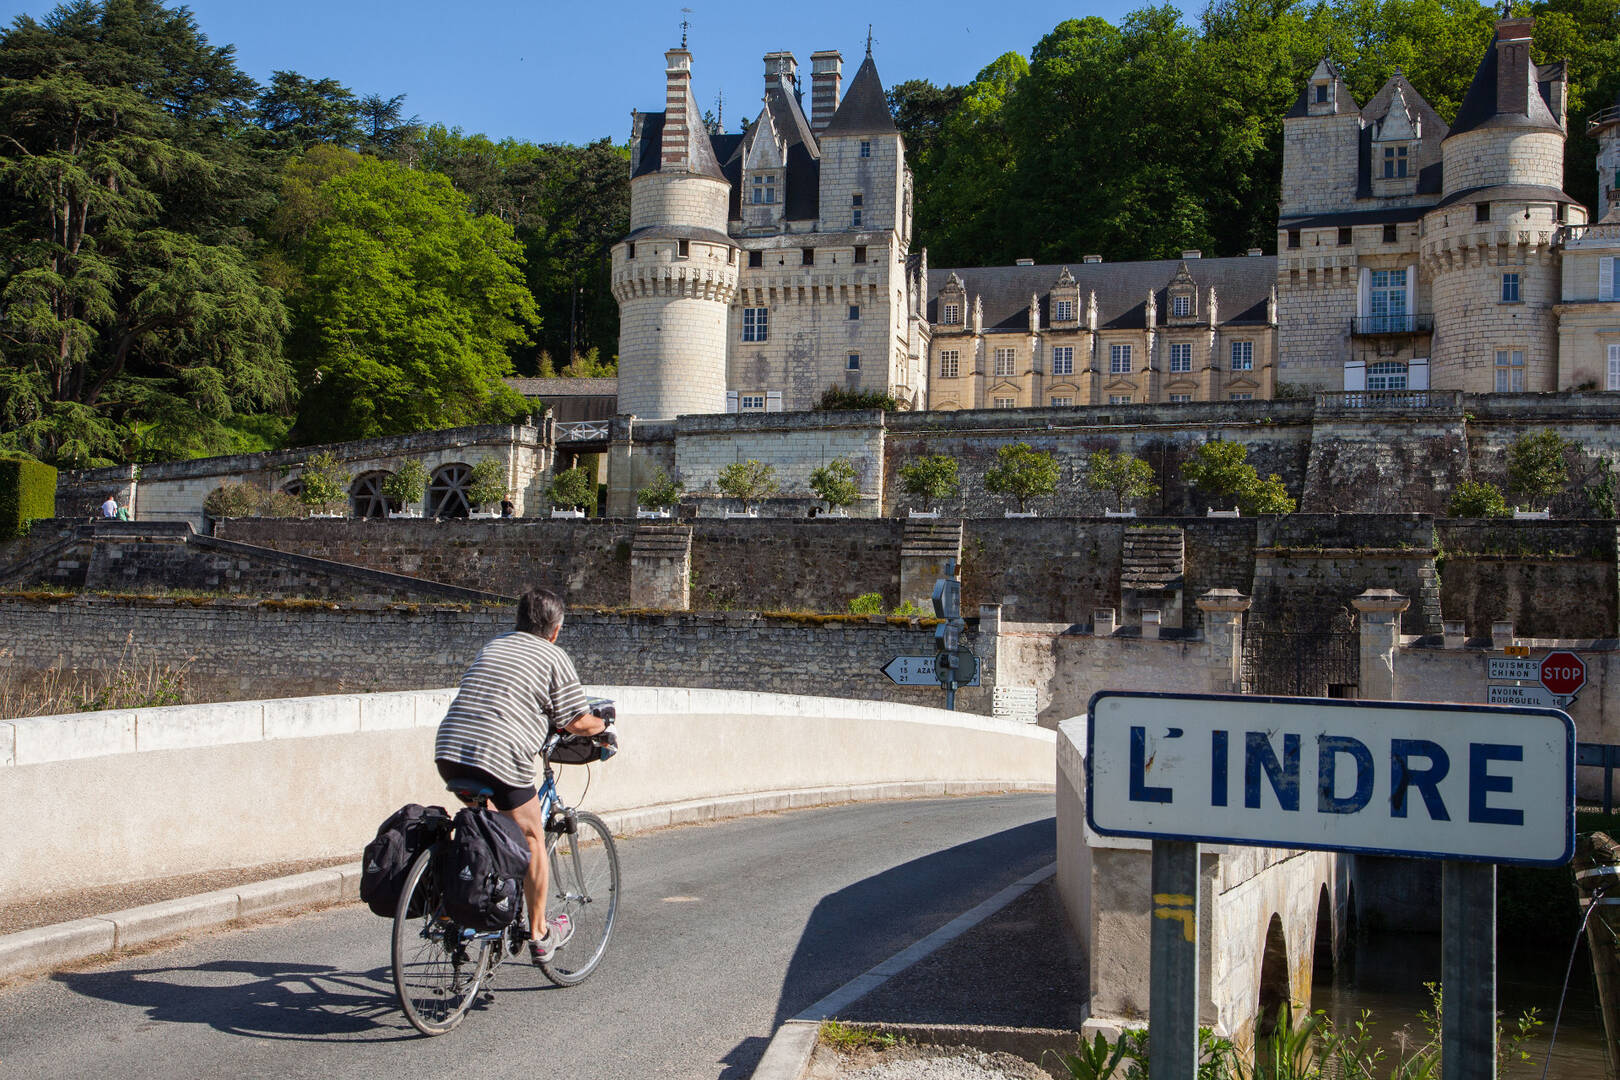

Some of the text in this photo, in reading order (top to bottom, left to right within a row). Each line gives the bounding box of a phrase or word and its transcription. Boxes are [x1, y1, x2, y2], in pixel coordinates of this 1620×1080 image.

[1492, 660, 1538, 670] HUISMES
[1544, 667, 1581, 680] STOP
[1491, 697, 1541, 705] BOURGUEIL
[1129, 726, 1524, 826] L'INDRE
